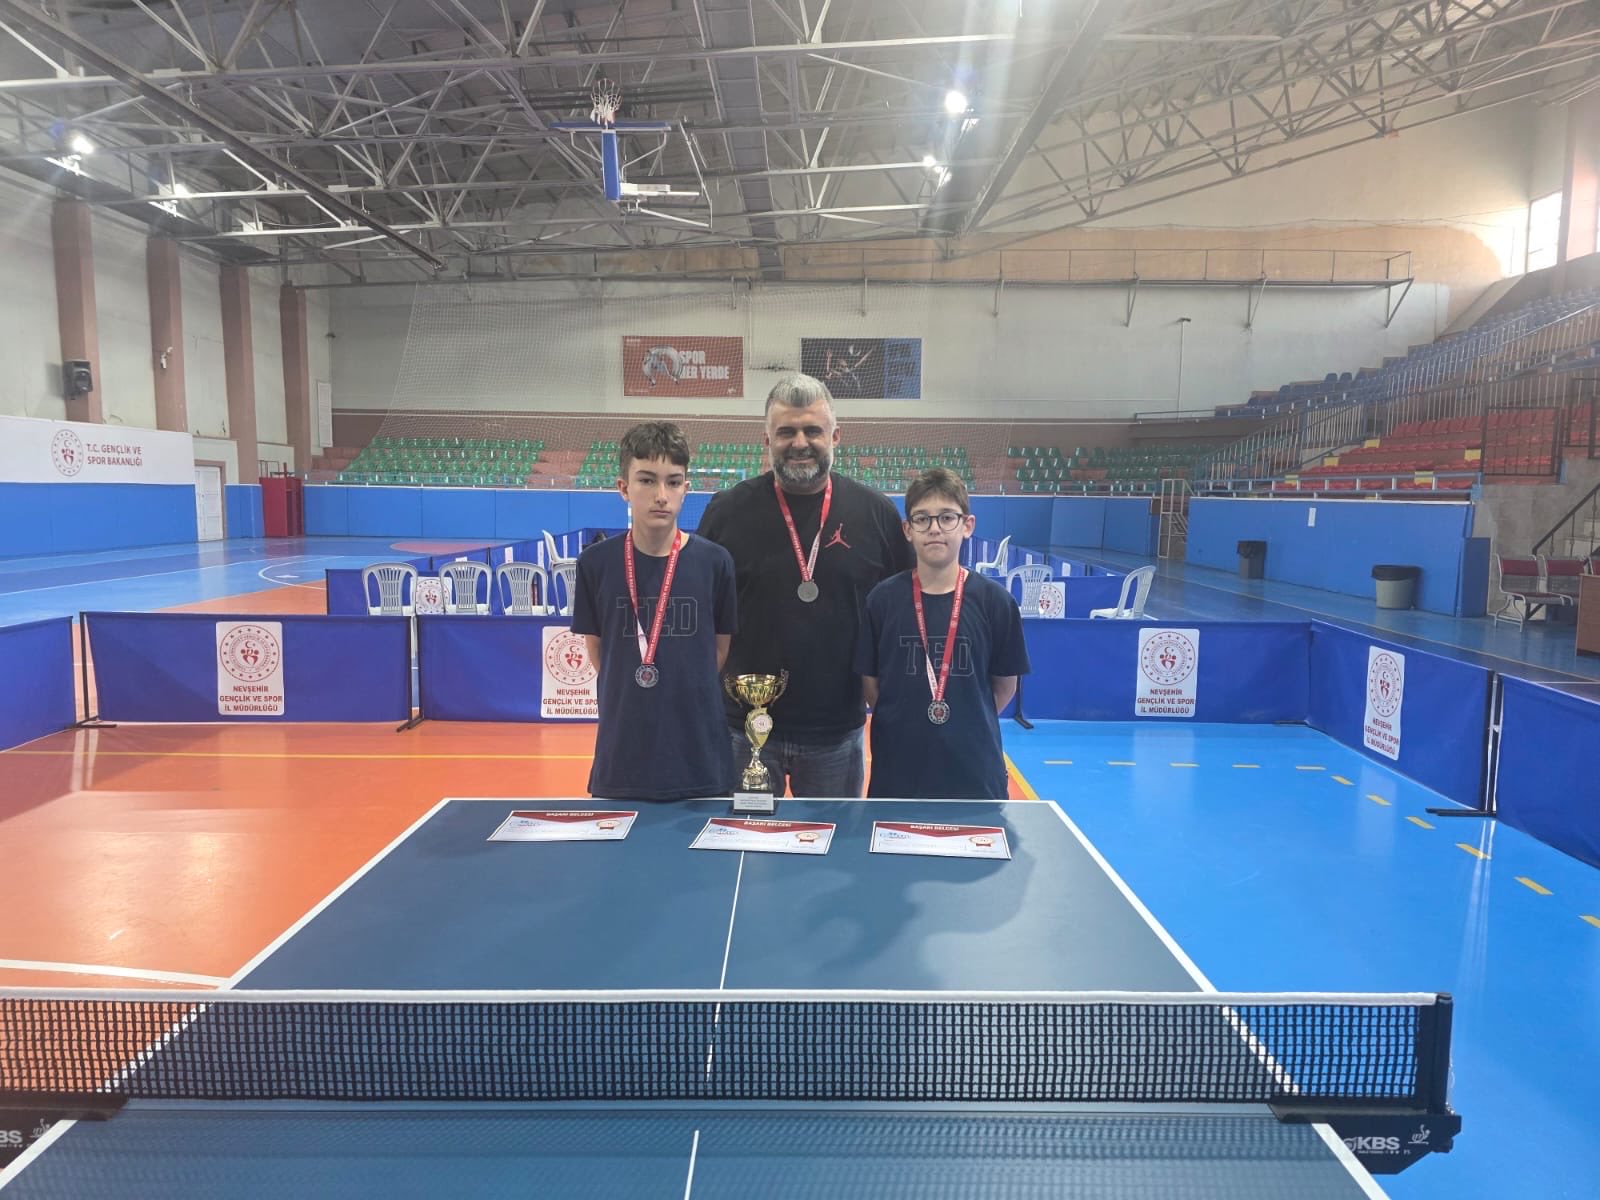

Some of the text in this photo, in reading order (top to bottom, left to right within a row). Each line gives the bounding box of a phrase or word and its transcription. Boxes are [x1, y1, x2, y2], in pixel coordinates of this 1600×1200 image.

[680, 350, 705, 364] SPOR
[86, 443, 142, 455] T.C. GENÇLİK VE
[87, 456, 142, 467] SPOR BAKANLIĞI
[616, 596, 698, 637] TED
[233, 685, 269, 694] NEVŞEHİR
[556, 688, 590, 697] NEVŞEHİR
[1150, 688, 1183, 697] NEVŞEHİR
[219, 694, 251, 704] GENÇLİK
[542, 697, 573, 706] GENÇLİK
[584, 698, 598, 706] SPO
[1136, 697, 1165, 706] GENÇLİK
[1166, 697, 1176, 705] VE
[224, 703, 279, 712] İL MÜDÜRLÜĞÜ
[546, 706, 553, 715] İL
[1140, 705, 1190, 714] İL MÜDÜRLÜĞÜ
[0, 1130, 22, 1144] BS
[1357, 1136, 1400, 1150] KBS
